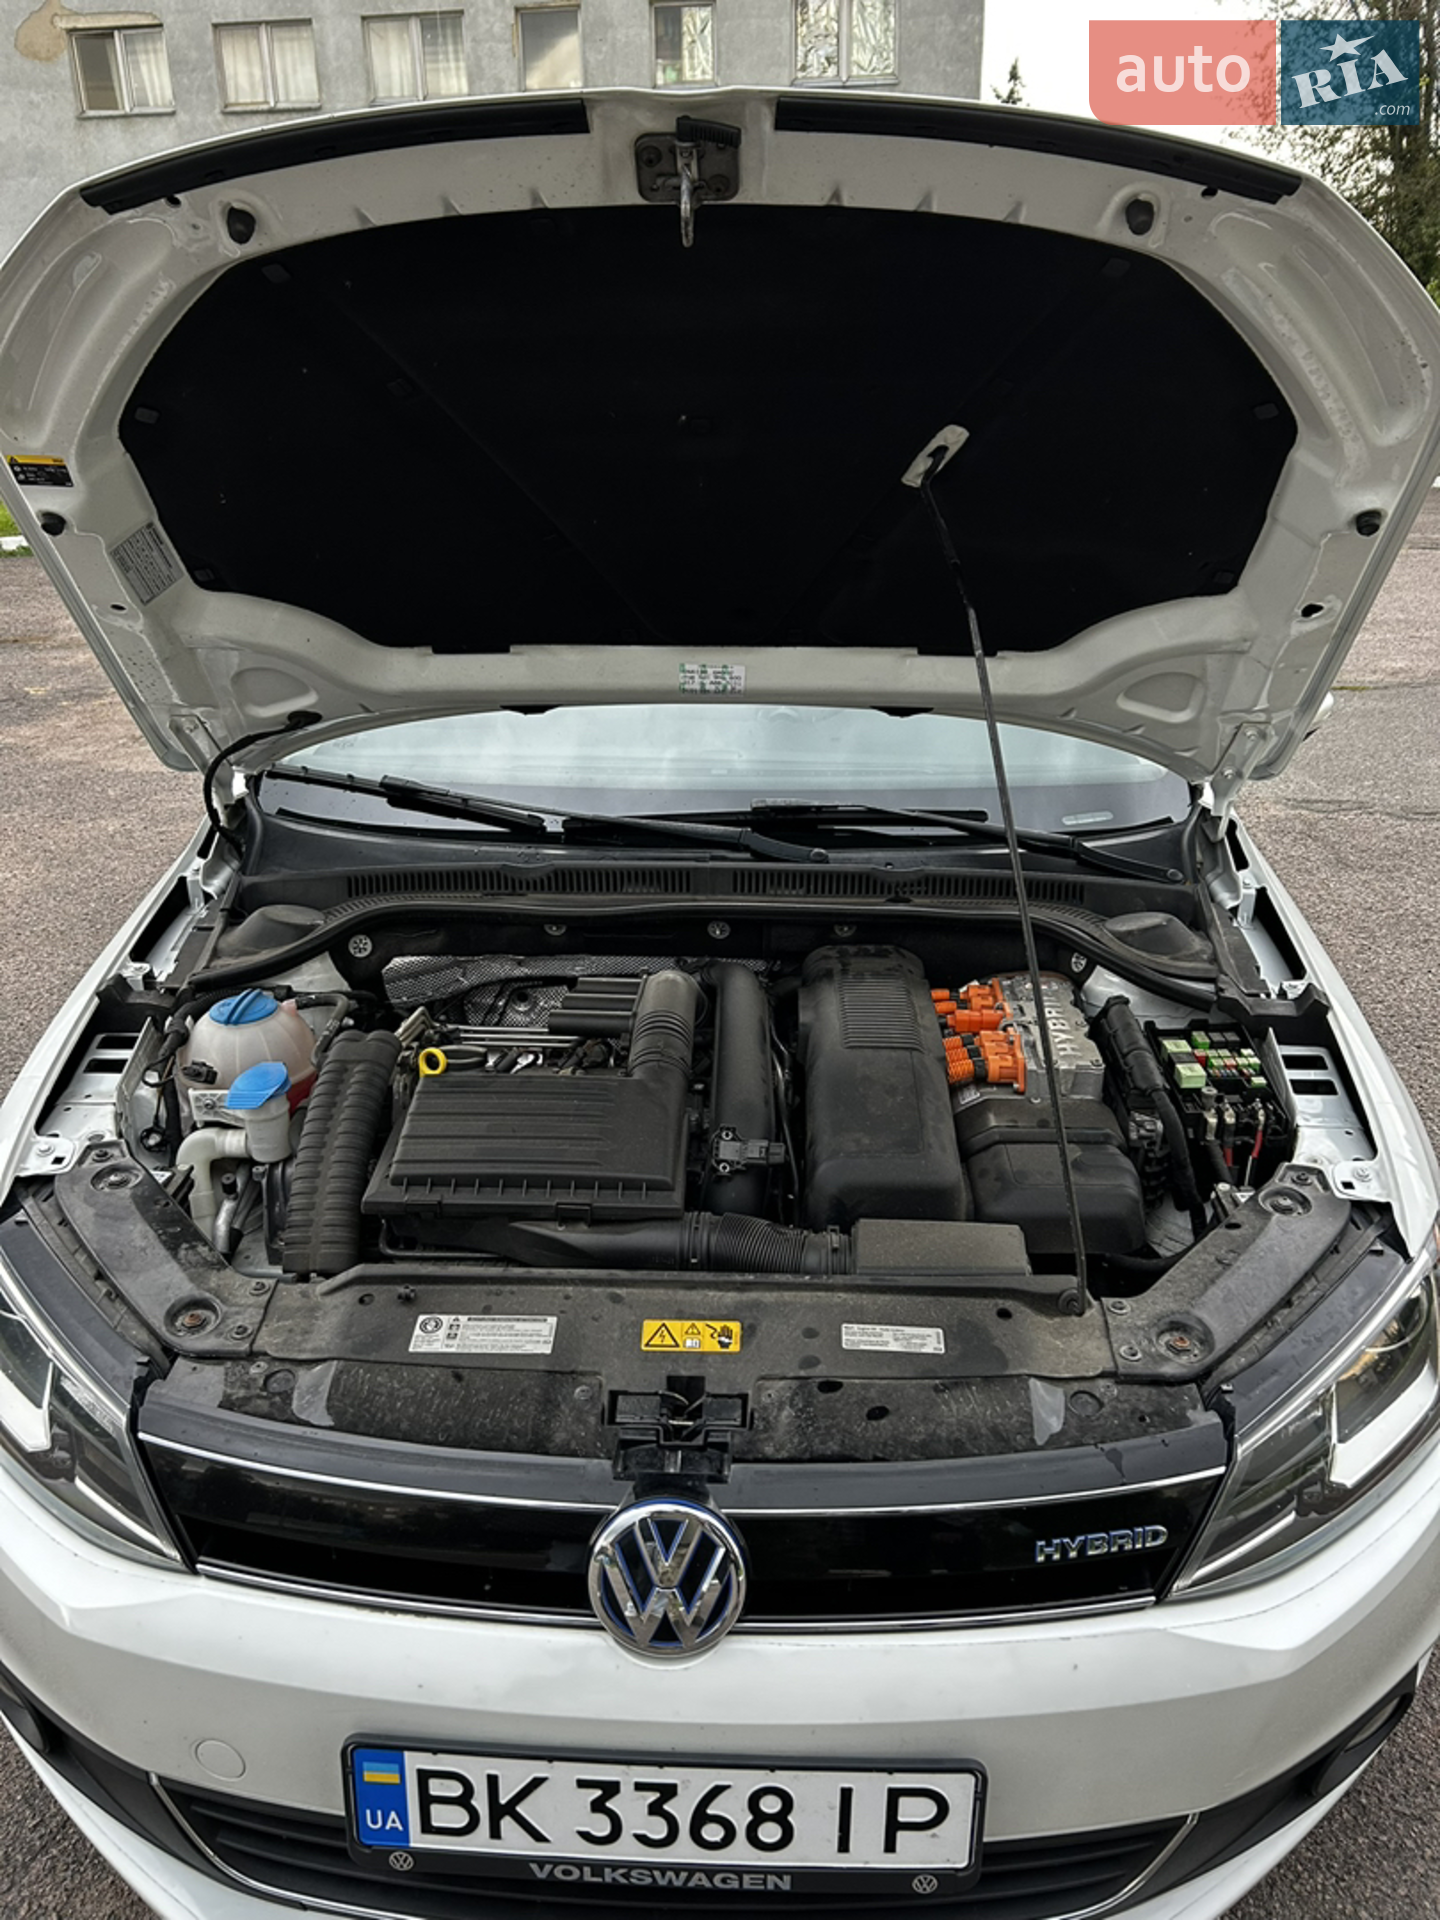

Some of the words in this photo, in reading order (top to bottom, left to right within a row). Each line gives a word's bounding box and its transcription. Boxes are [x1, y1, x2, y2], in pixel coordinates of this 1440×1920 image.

[1035, 1524, 1168, 1563] HYBRID
[365, 1809, 404, 1831] UA
[416, 1767, 551, 1843] BK
[575, 1778, 795, 1852] 3368
[837, 1786, 950, 1853] IP
[529, 1862, 792, 1891] VOLKSWAGEN
